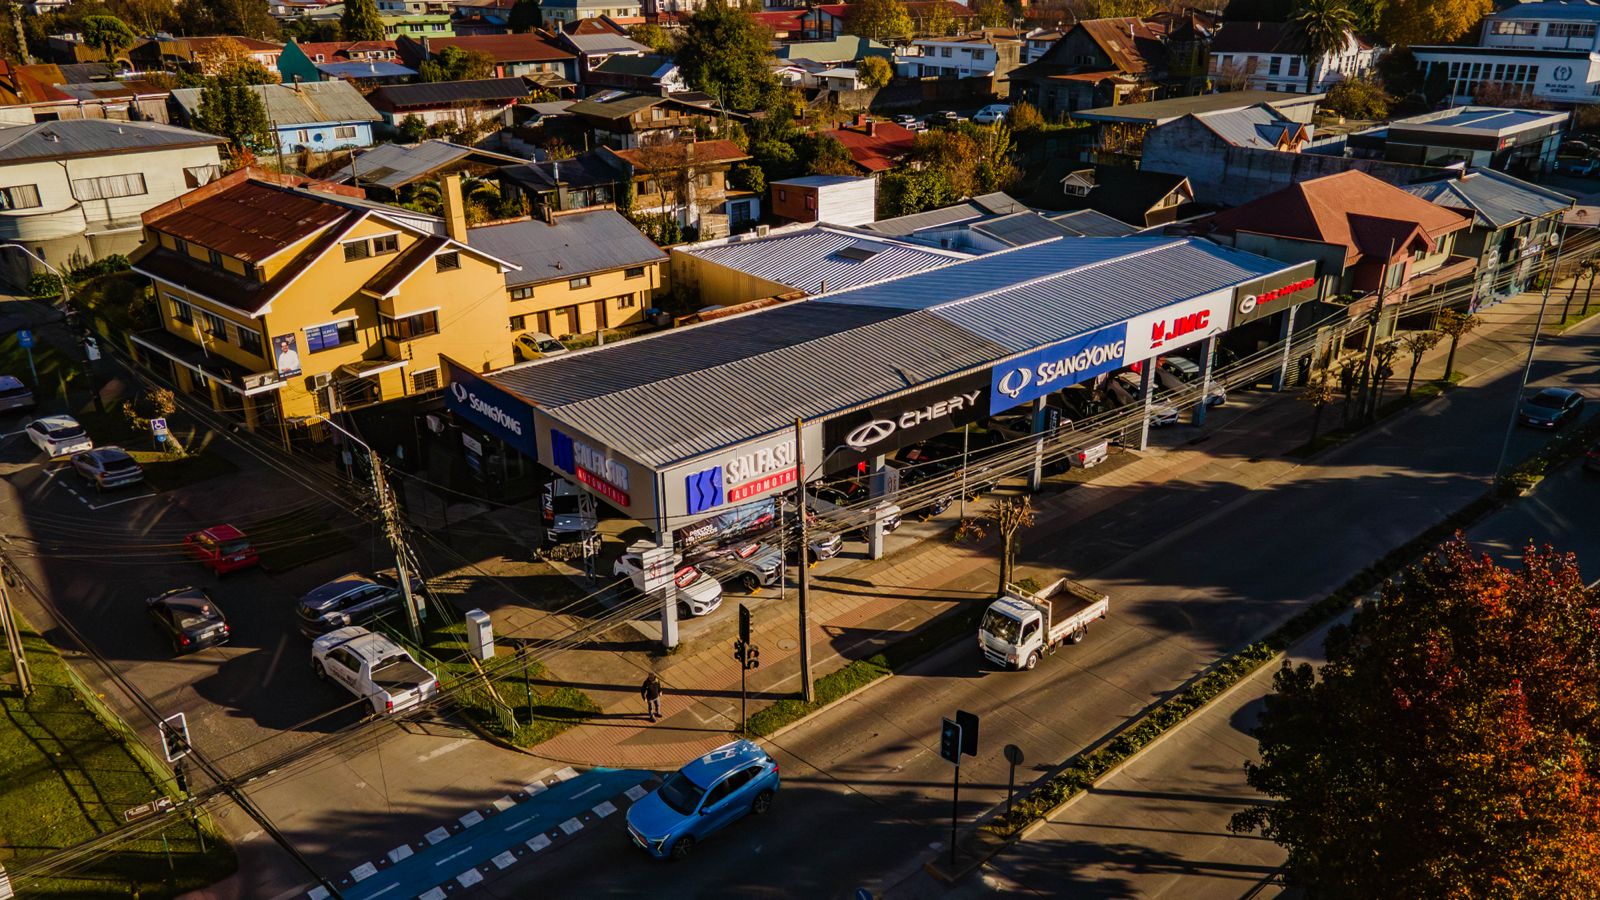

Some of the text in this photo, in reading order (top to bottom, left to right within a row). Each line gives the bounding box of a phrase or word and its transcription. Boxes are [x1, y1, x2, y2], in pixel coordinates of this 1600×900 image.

[1165, 309, 1211, 341] JMC
[898, 389, 981, 430] CHERY
[726, 439, 804, 484] SALFASU
[734, 473, 798, 501] AUTOMOTRI
